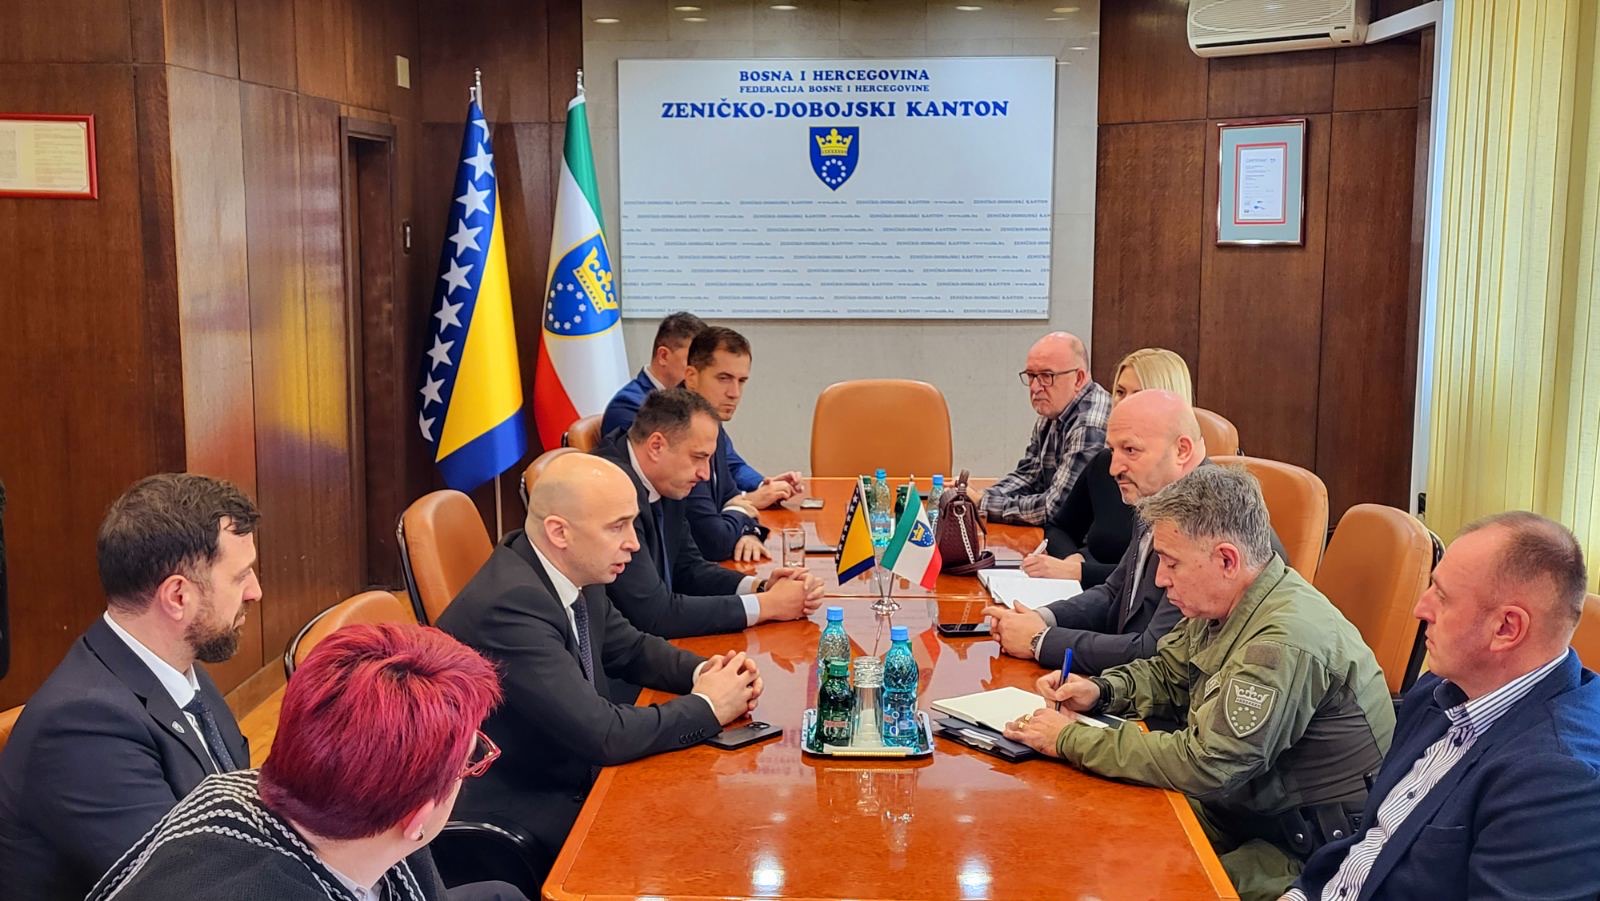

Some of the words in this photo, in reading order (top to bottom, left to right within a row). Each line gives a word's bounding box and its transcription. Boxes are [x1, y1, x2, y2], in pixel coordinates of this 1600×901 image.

[739, 70, 794, 82] BOSNA
[800, 70, 806, 81] I
[813, 69, 930, 81] HERCEGOVINA
[739, 85, 805, 93] FEDERACIJA
[808, 85, 843, 93] BOSNE
[855, 84, 930, 93] HERCEGOVINE
[661, 97, 895, 118] ZENIČKO-DOBOJSKI
[906, 100, 1009, 117] KANTON
